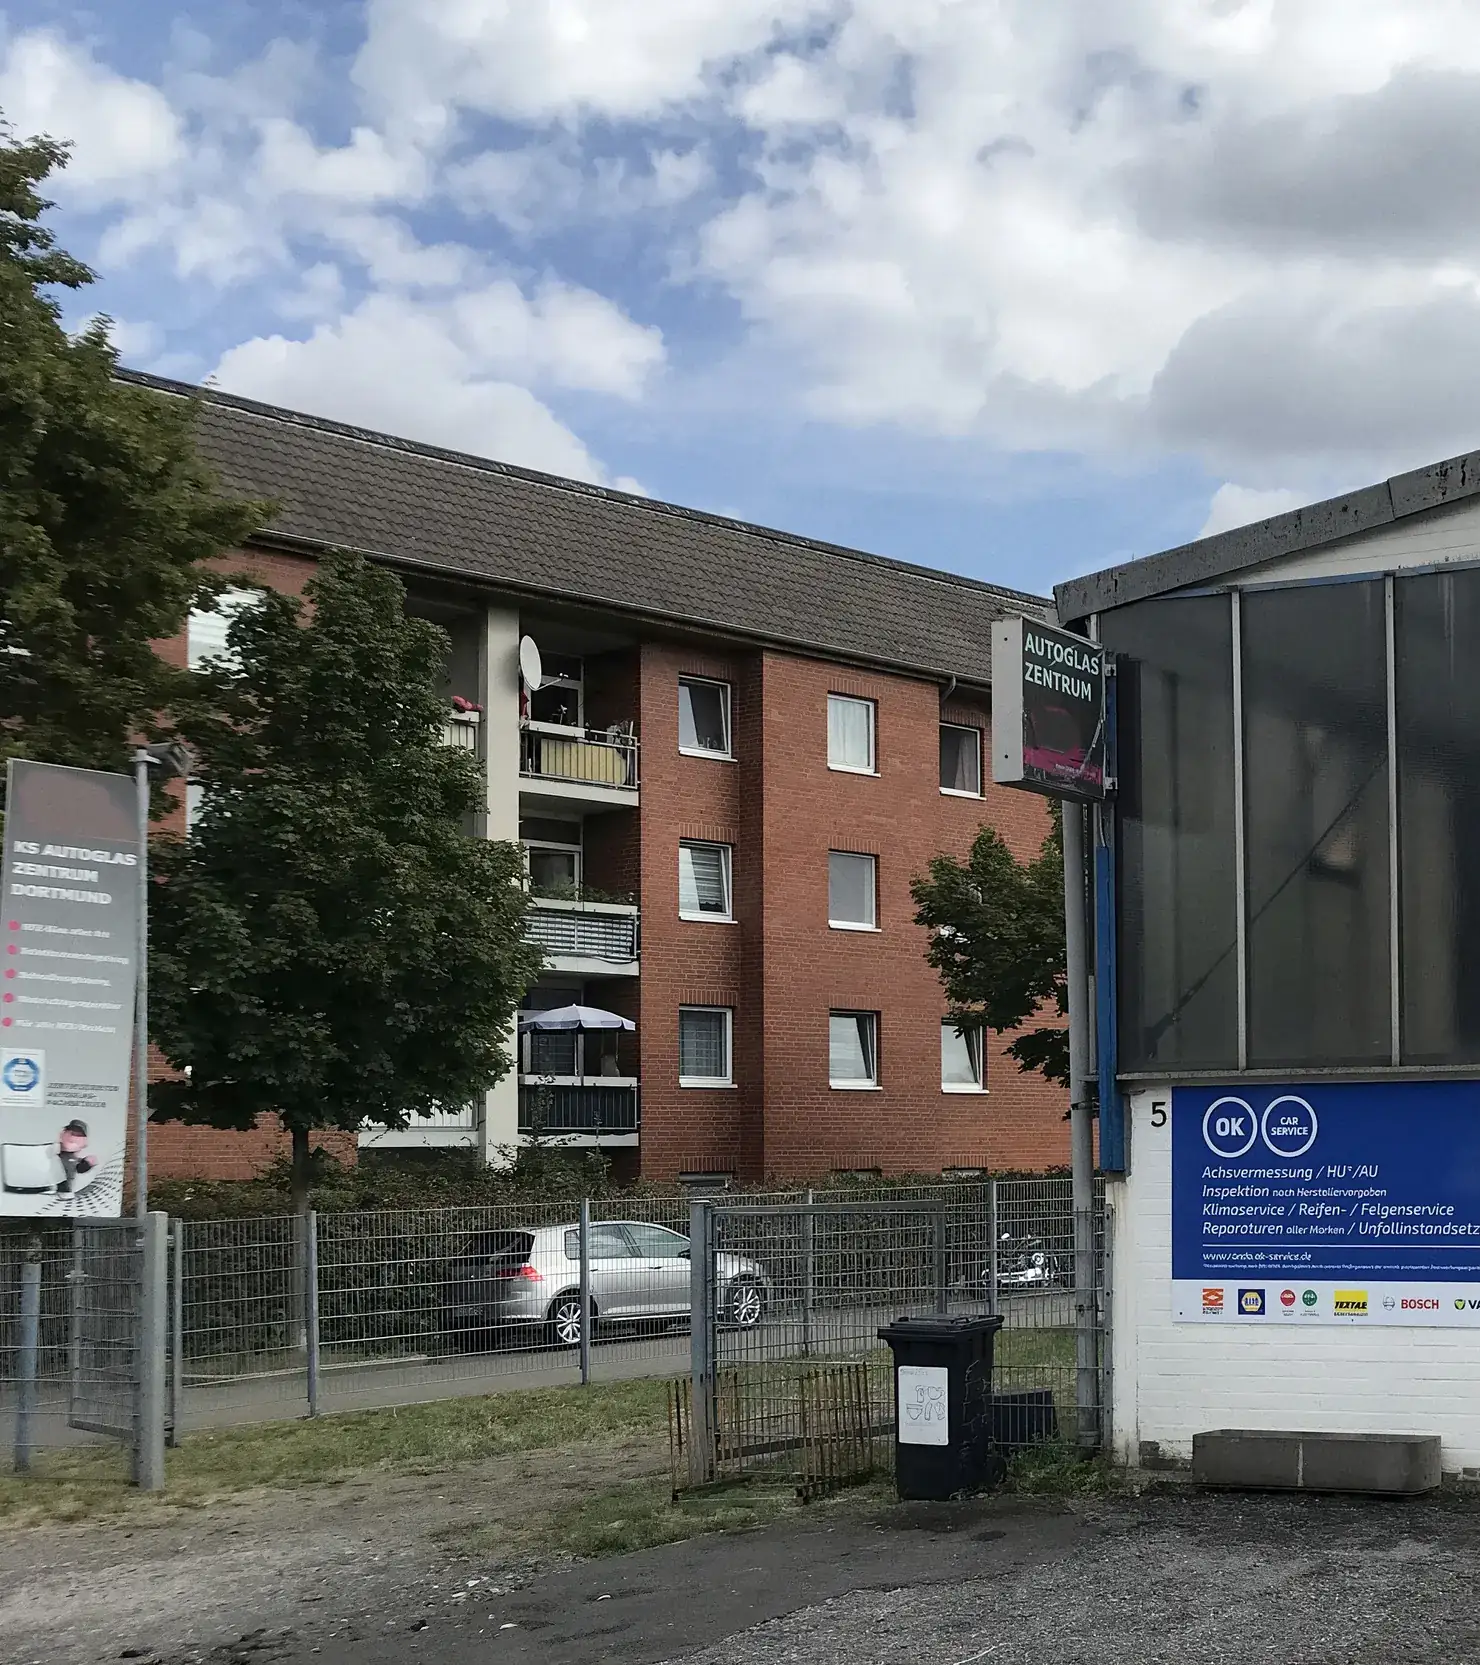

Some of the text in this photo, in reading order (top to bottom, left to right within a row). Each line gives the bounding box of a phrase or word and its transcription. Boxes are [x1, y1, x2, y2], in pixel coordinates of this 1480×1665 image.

[1025, 632, 1100, 676] AUTOGLAS
[1024, 661, 1092, 702] ZENTRUM
[13, 840, 138, 866] KS AUTOGLAS
[12, 861, 98, 882] ZENTRUM
[10, 883, 112, 904] DORTMUND
[1150, 1101, 1168, 1128] 5
[1280, 1116, 1299, 1126] CAR
[1215, 1117, 1245, 1136] OK
[1271, 1126, 1309, 1136] SERVICE
[1202, 1166, 1313, 1181] Achsvermessung
[1202, 1184, 1270, 1200] Inspektion
[1272, 1187, 1295, 1197] nach
[1202, 1203, 1285, 1216] Klimaservice
[1298, 1203, 1347, 1219] Reifen-
[1360, 1203, 1455, 1219] Felgenservice
[1202, 1221, 1283, 1237] Reparaturen
[1286, 1225, 1309, 1235] aller
[1309, 1225, 1345, 1235] Marken
[1400, 1299, 1440, 1310] BOSCH
